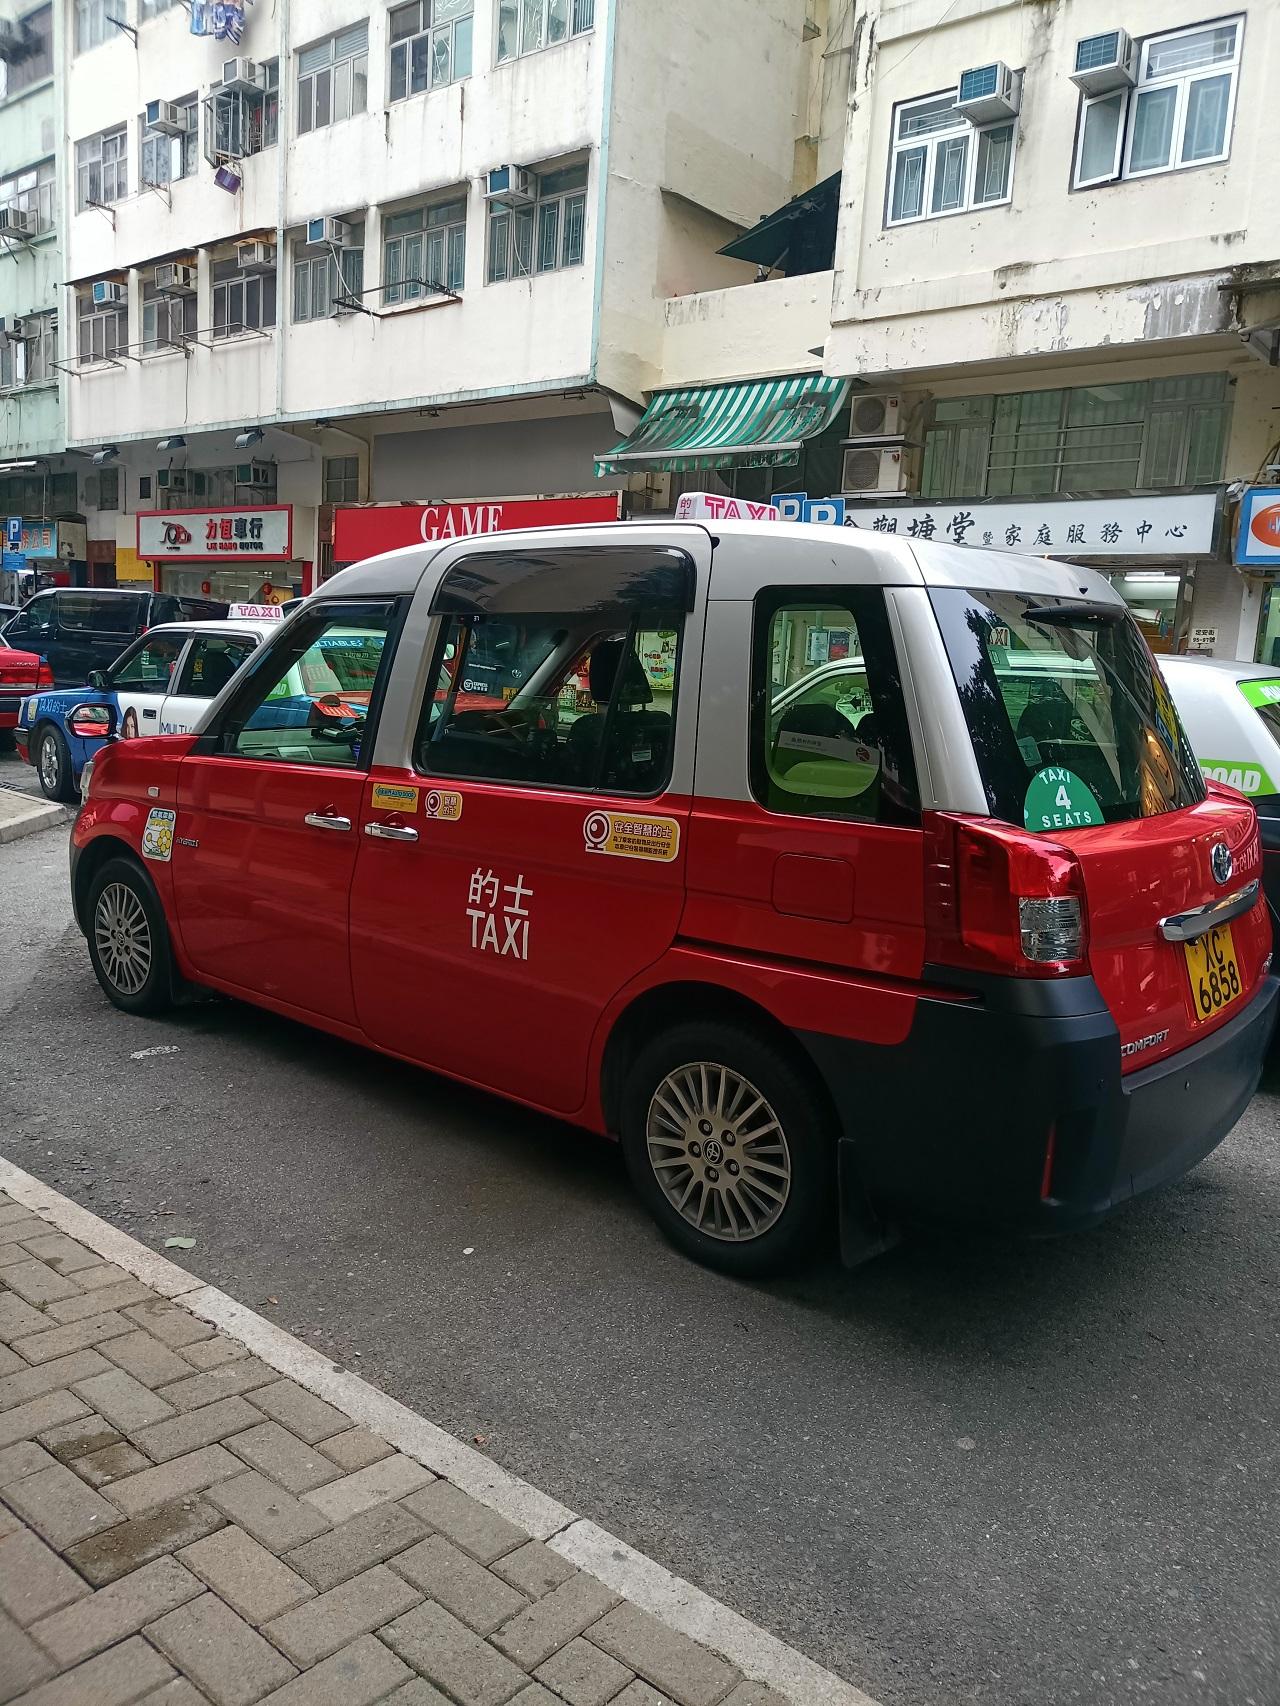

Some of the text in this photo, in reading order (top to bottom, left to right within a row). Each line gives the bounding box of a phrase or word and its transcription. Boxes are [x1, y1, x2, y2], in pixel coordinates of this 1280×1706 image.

[704, 496, 777, 520] TAXI
[10, 520, 19, 540] P
[420, 505, 503, 542] GAME
[238, 605, 280, 616] TAXI
[1038, 768, 1071, 785] TAXI
[1055, 785, 1072, 810] 4
[1042, 810, 1092, 828] SEATS
[468, 867, 534, 916] 的士
[465, 908, 530, 961] TAXI
[1201, 929, 1224, 973] XC
[1199, 959, 1240, 1014] 6858
[1121, 1028, 1170, 1057] COMFORT
